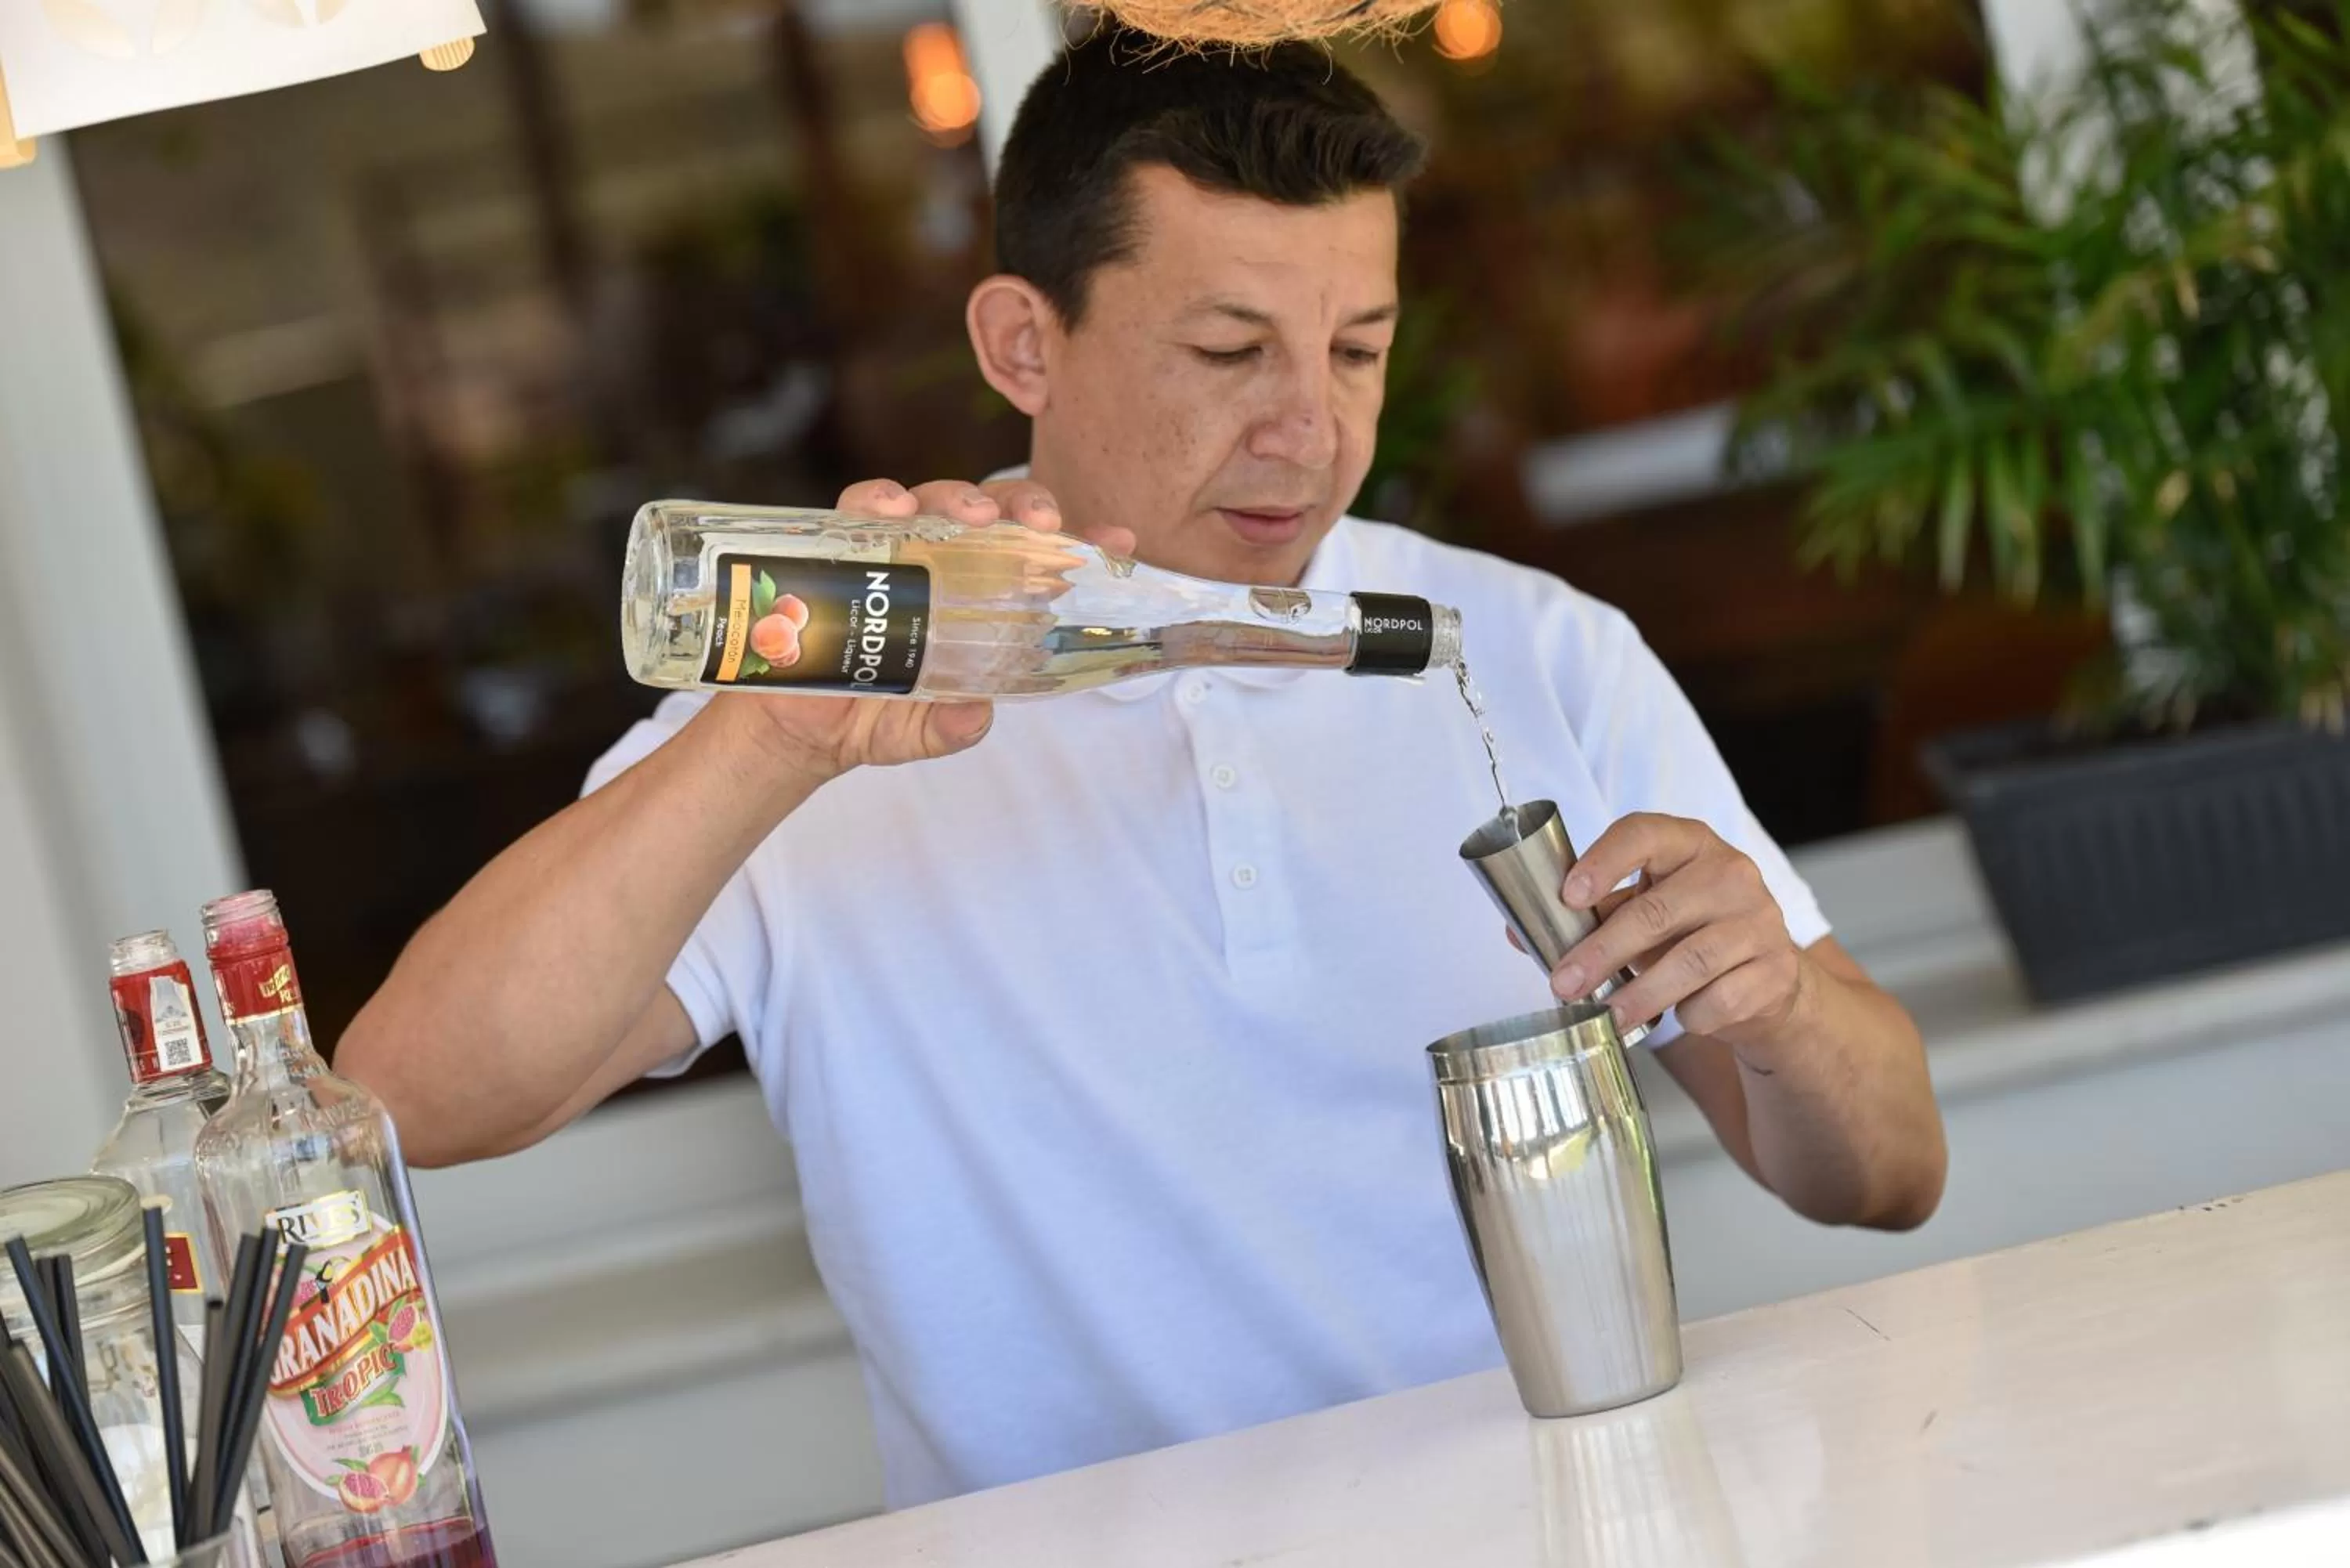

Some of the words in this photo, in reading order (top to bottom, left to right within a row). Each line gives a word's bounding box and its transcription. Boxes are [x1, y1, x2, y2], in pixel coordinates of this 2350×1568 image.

[850, 599, 861, 627] Licor
[1364, 616, 1423, 630] NORDPOL
[850, 571, 891, 688] NORDPOL
[905, 649, 916, 668] 1940
[310, 1342, 397, 1418] TROPIC
